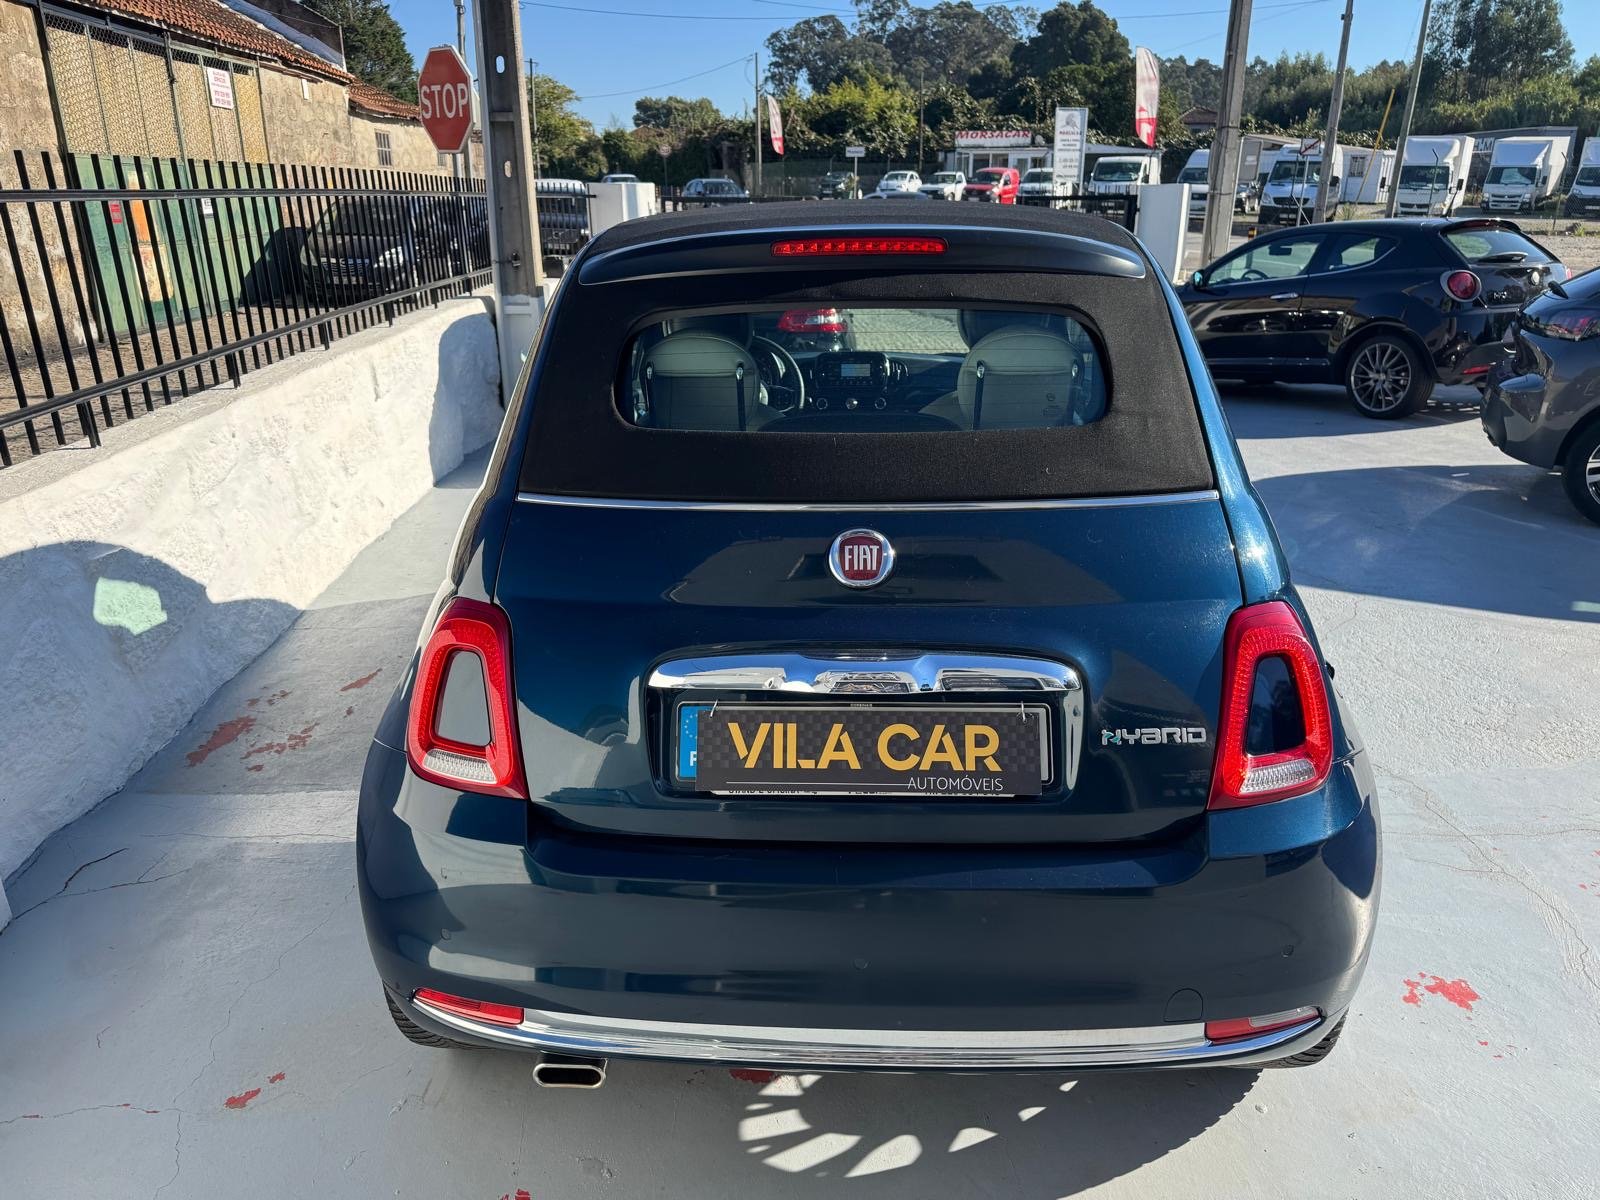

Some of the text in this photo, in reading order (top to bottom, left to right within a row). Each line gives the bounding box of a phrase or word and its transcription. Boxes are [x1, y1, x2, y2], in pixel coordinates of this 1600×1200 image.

[421, 82, 468, 119] STOP
[844, 544, 880, 571] FIAT
[727, 722, 1003, 772] VILA CAR
[1101, 727, 1207, 746] HYBRID
[907, 774, 1004, 791] AUTOMÓVEIS
